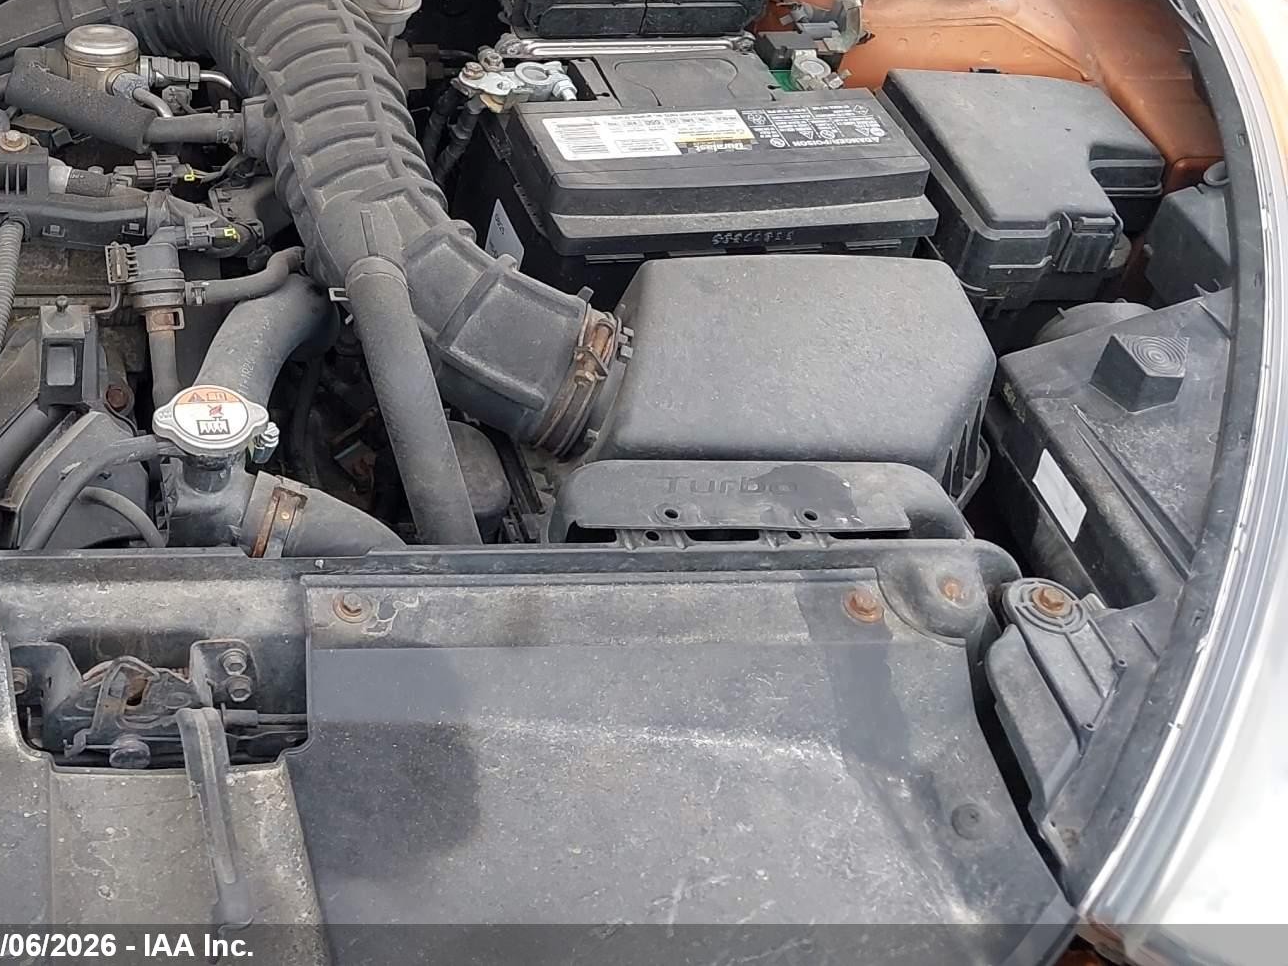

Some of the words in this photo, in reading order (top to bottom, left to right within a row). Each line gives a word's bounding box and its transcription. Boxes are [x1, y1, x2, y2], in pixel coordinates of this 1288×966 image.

[695, 142, 745, 152] Duralast
[791, 136, 874, 147] DANGER/POISON
[657, 476, 798, 495] Turbo
